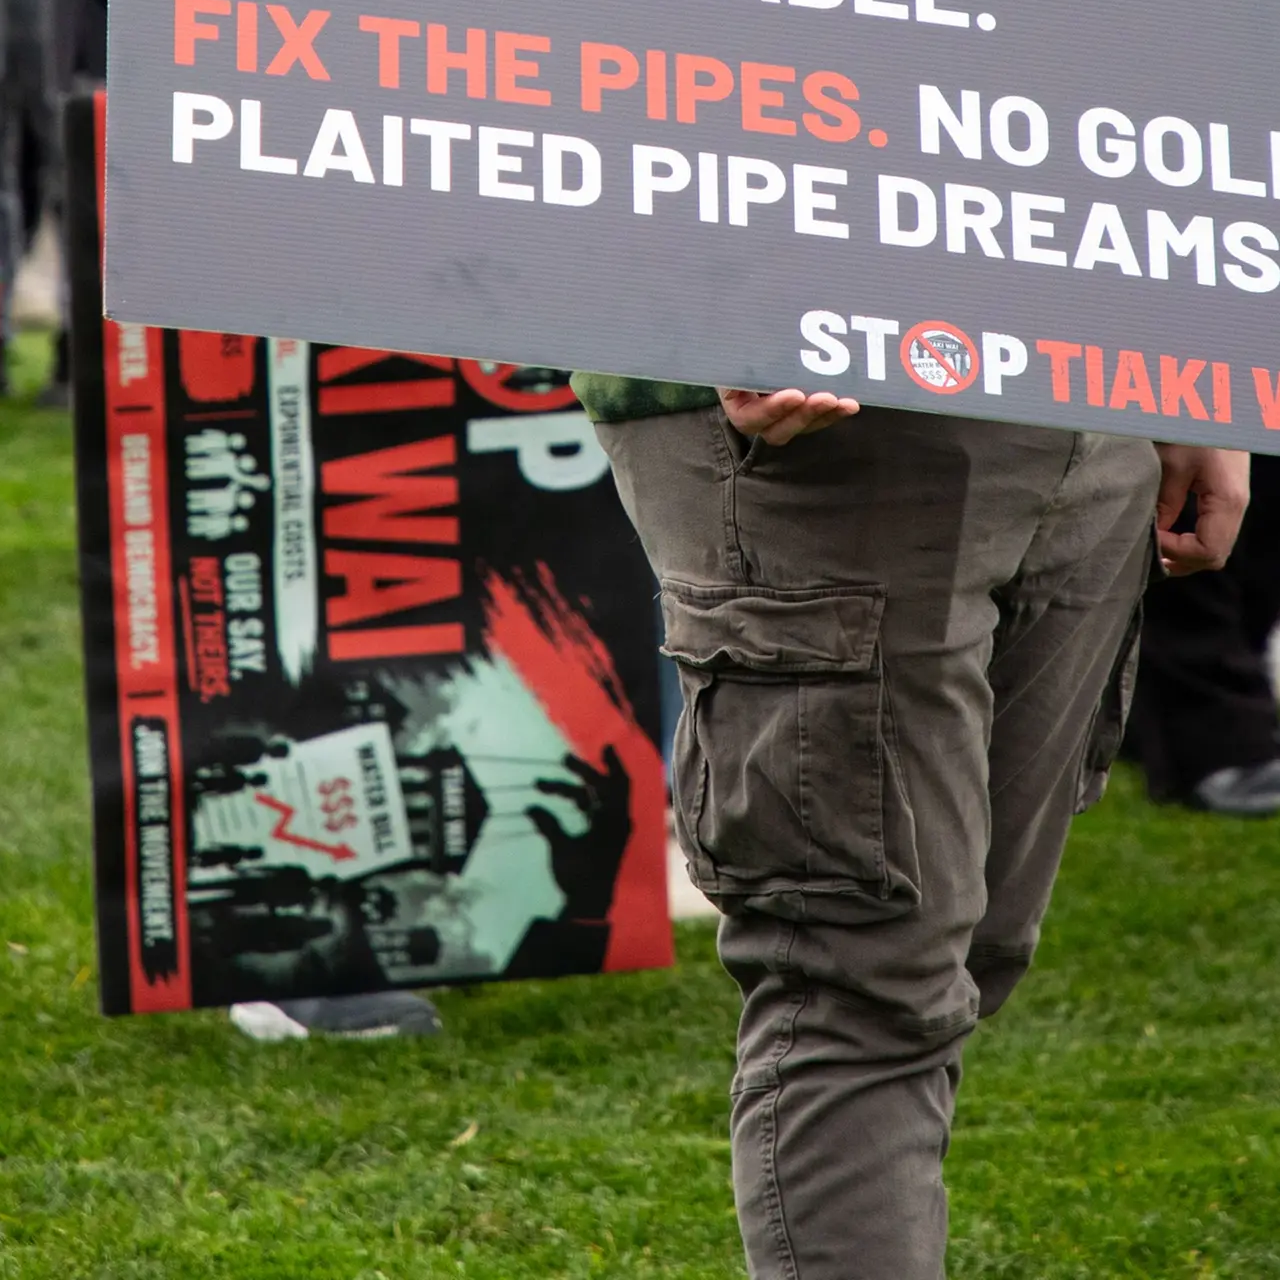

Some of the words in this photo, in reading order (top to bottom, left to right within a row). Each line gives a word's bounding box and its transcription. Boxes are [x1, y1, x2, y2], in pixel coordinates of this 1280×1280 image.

[359, 15, 551, 106] THE
[581, 42, 887, 148] PIPES.
[918, 84, 1050, 167] NO
[172, 91, 602, 207] PLAITED
[632, 143, 850, 239] PIPE
[1036, 339, 1232, 423] TIAKI
[189, 557, 223, 603] NOT
[224, 552, 263, 612] OUR
[321, 434, 465, 661] WAI
[194, 610, 231, 704] THEIRS.
[228, 618, 267, 681] SAY.
[139, 780, 169, 820] THE
[356, 742, 388, 810] WATER
[370, 812, 398, 855] BILL
[140, 824, 174, 948] MOVEMENT.
